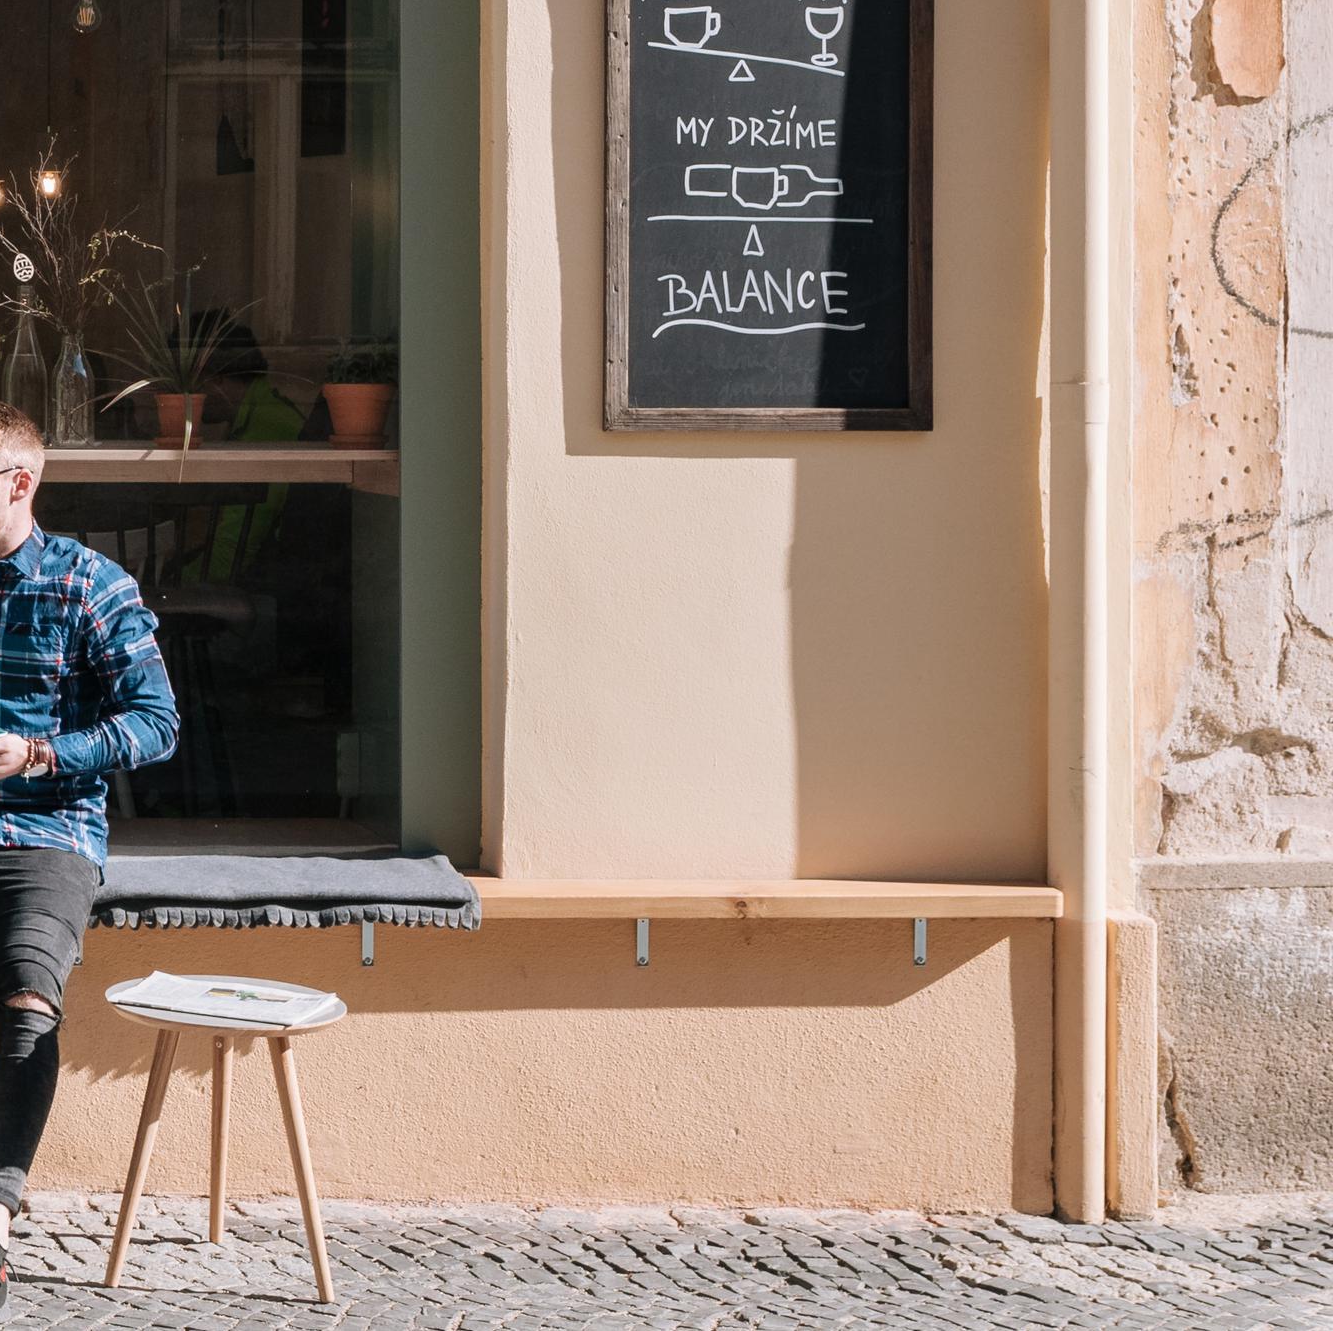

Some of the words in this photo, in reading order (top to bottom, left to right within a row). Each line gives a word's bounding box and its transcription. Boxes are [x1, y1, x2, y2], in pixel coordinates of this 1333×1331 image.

[675, 116, 716, 148] MY
[727, 105, 837, 150] DRŽÍME
[656, 267, 849, 317] BALANCE
